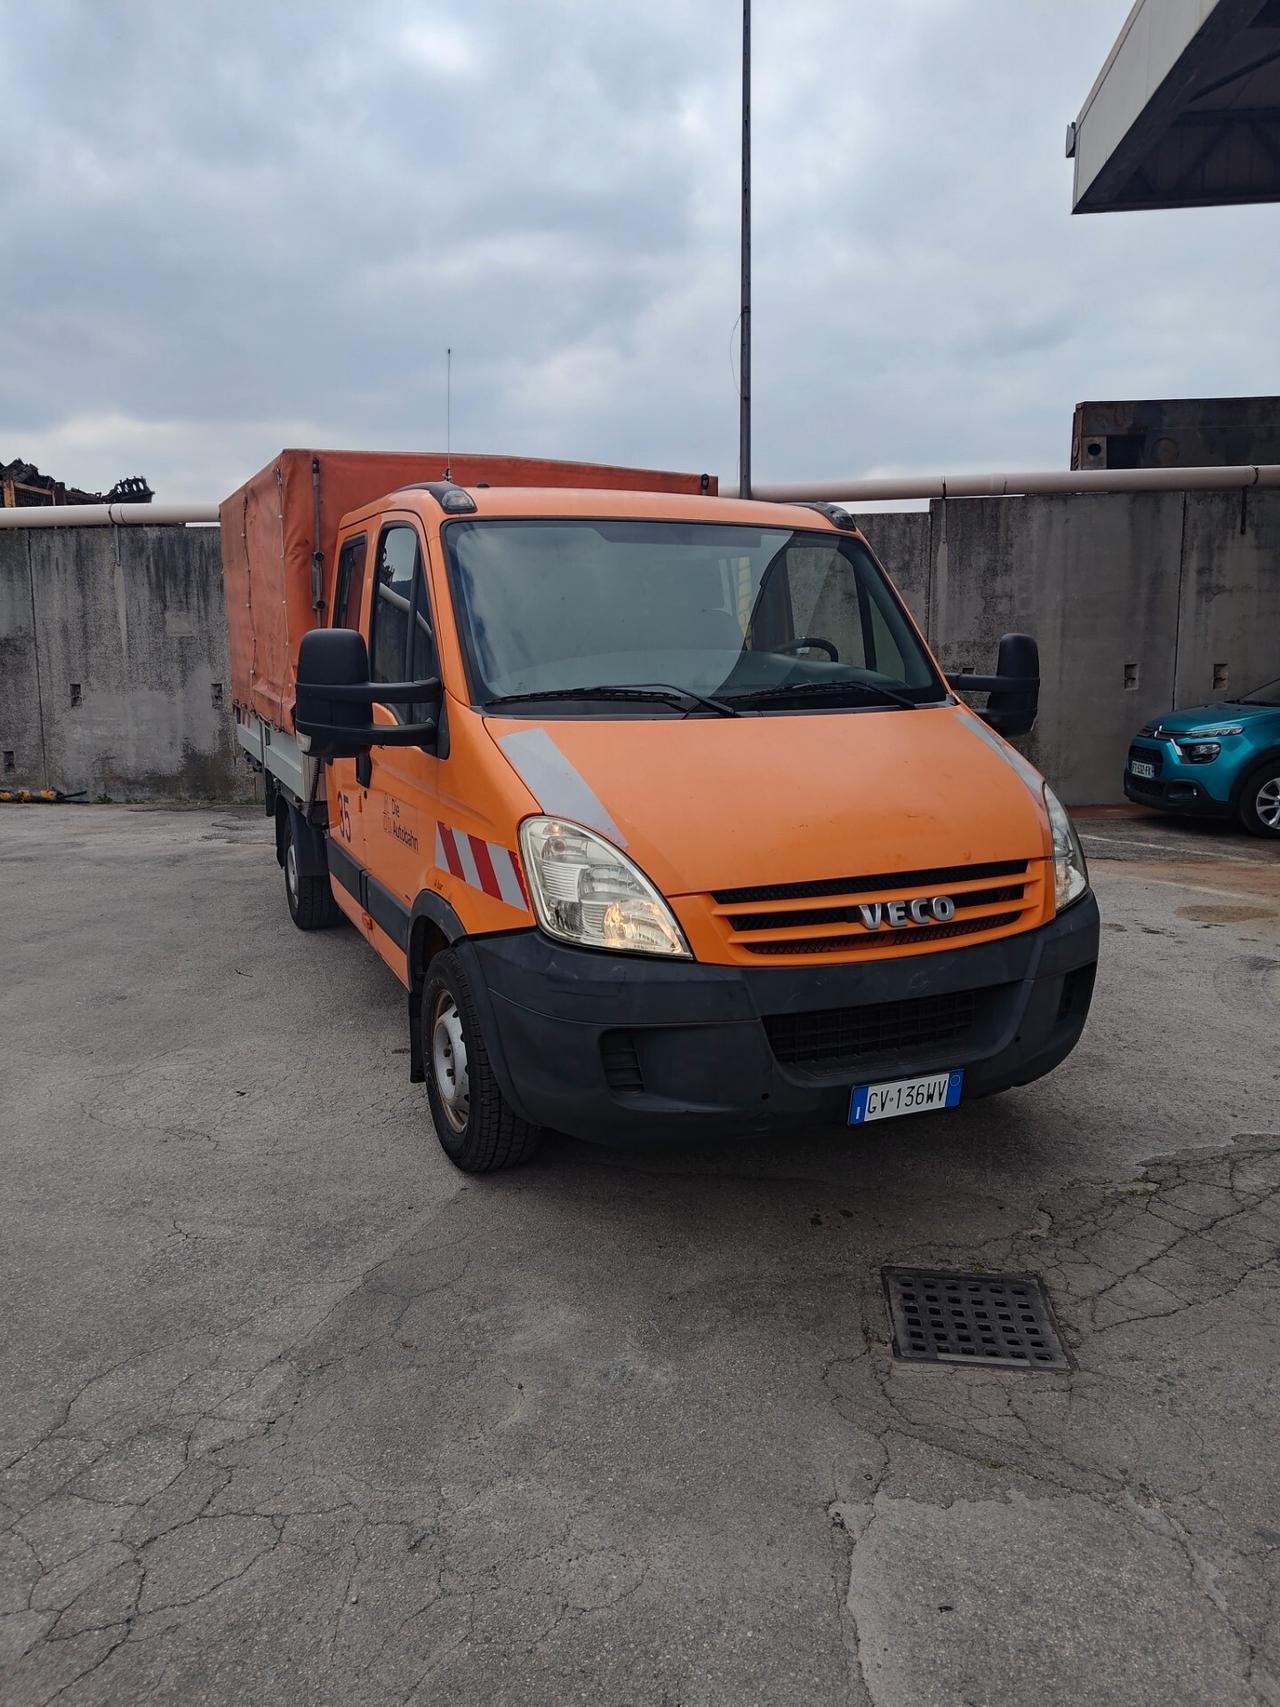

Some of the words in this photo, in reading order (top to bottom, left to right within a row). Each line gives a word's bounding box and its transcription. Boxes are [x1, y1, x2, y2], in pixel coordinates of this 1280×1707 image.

[338, 791, 351, 843] 35
[391, 798, 400, 818] Die
[393, 820, 419, 852] Autobahn
[858, 895, 955, 930] VECO
